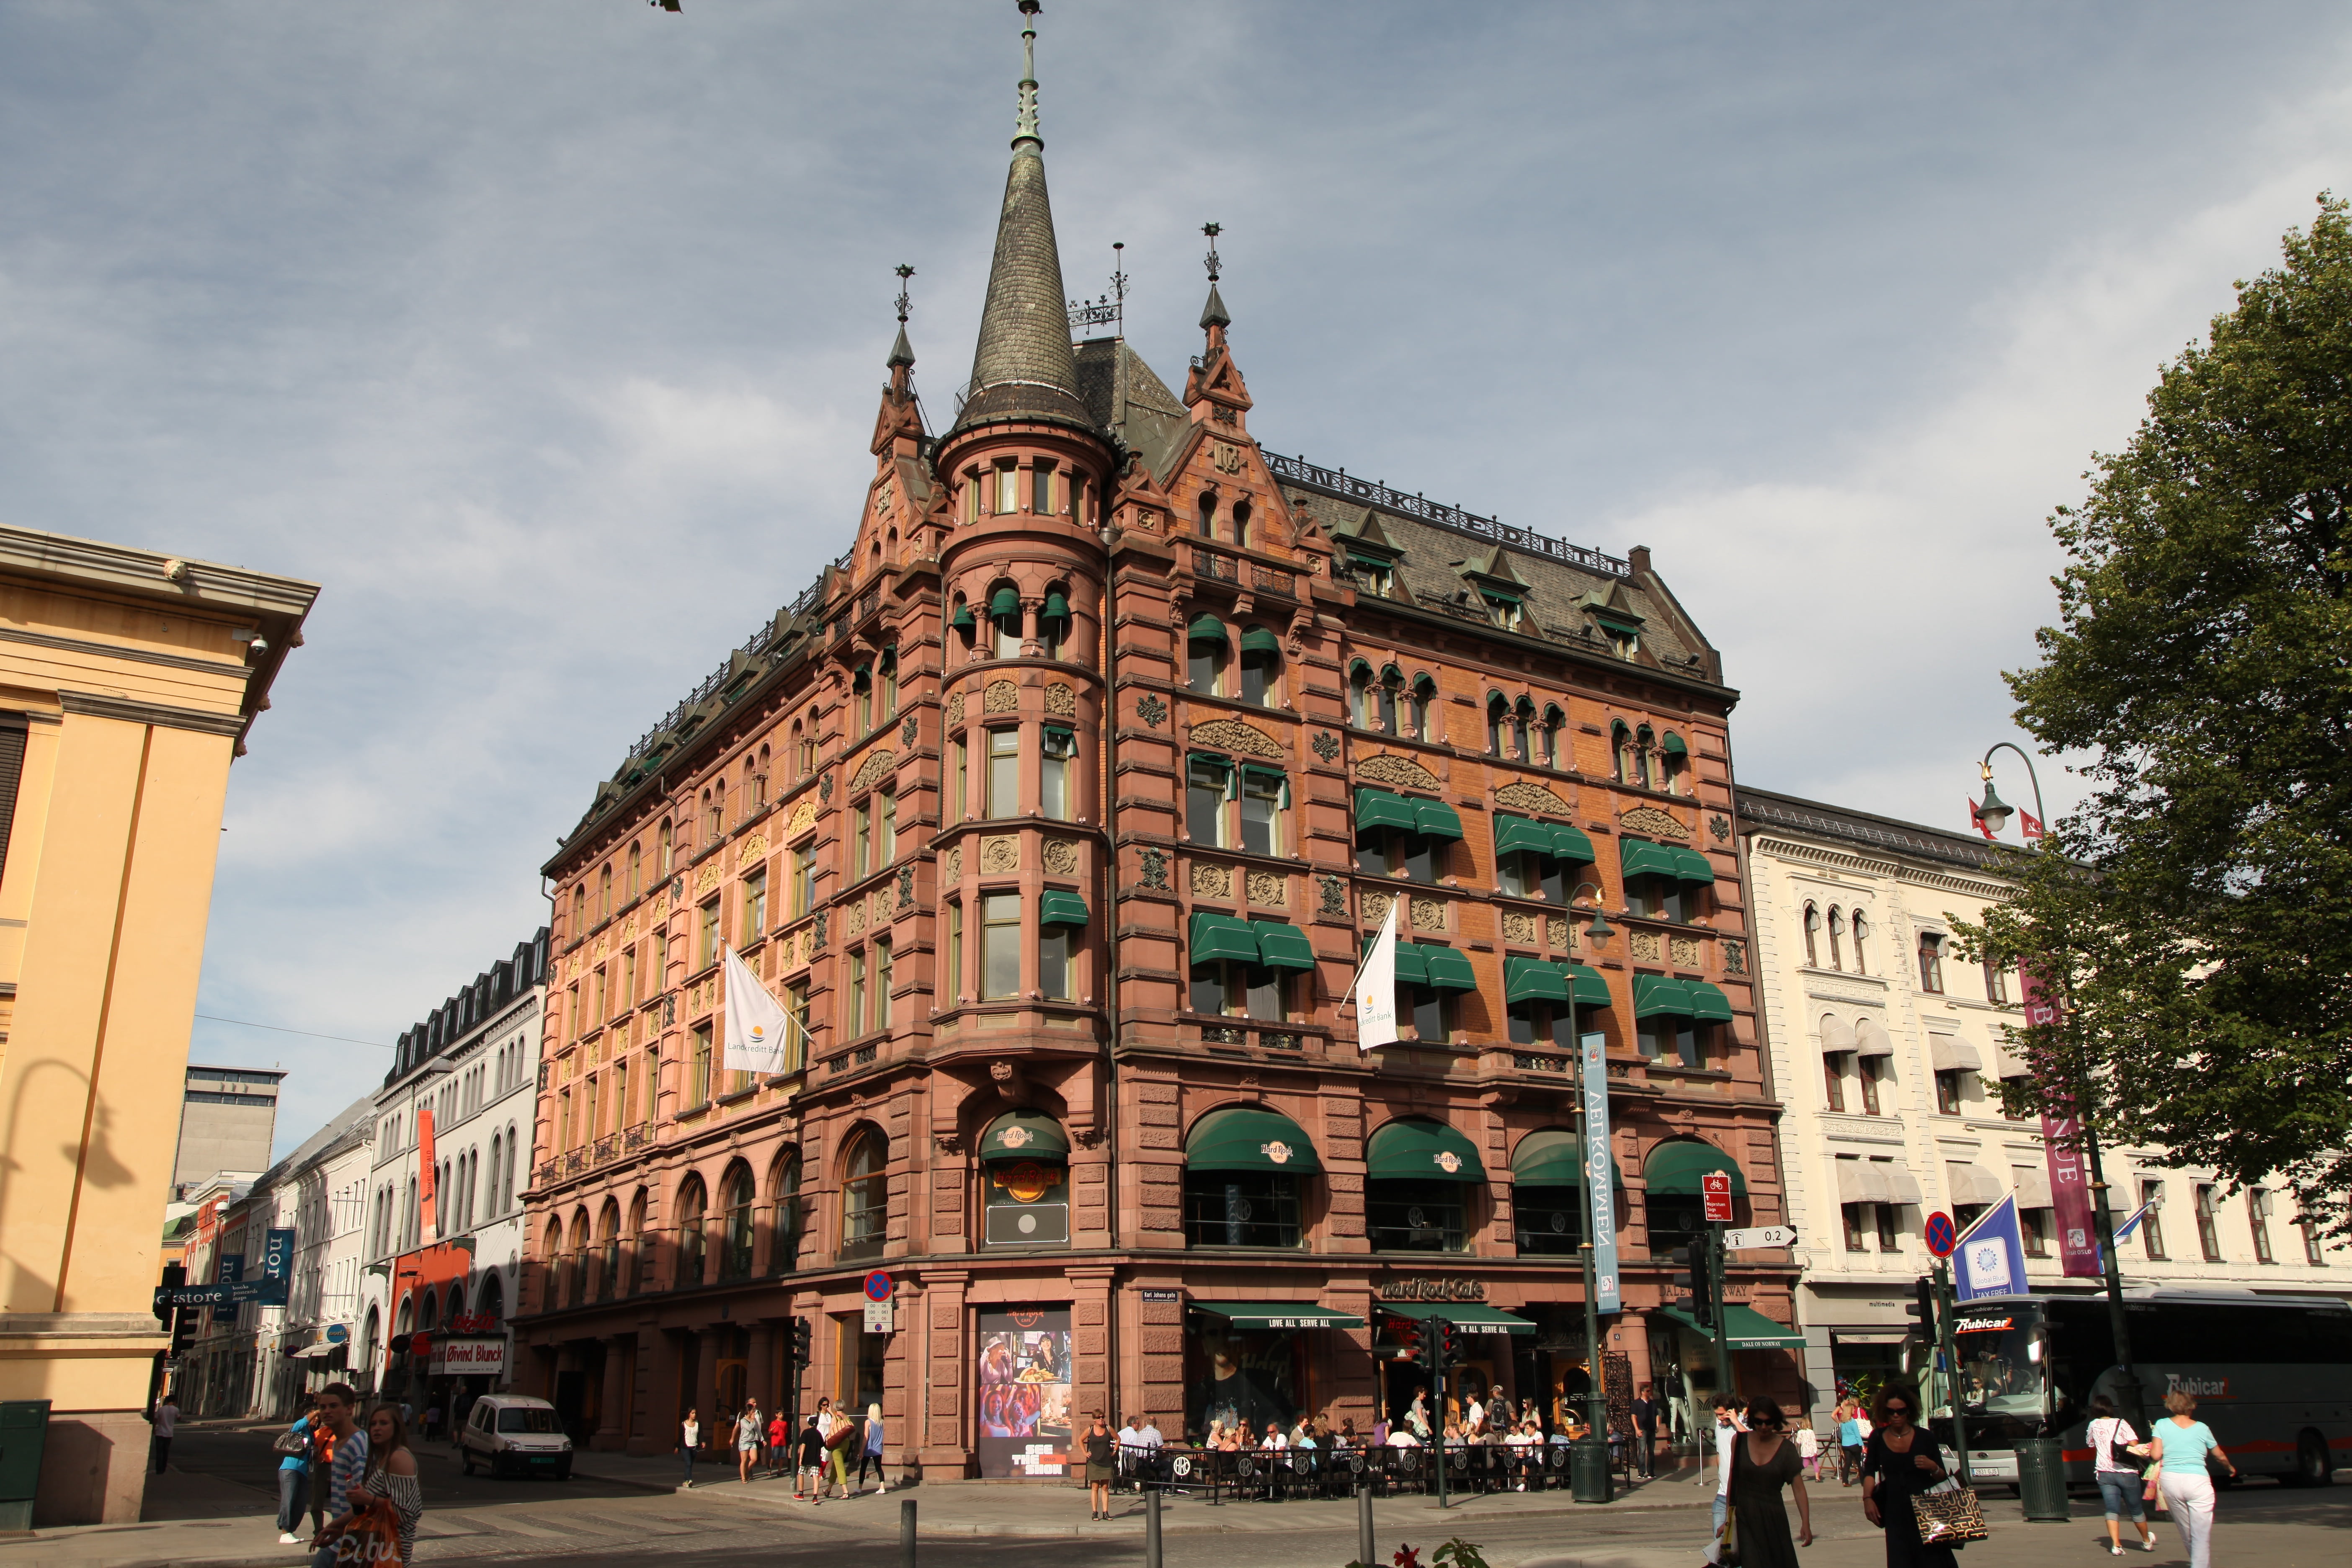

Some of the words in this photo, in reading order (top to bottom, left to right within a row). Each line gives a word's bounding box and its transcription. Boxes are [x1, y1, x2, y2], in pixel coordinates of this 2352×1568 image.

[1270, 456, 1626, 575] ANDKREDITT
[1377, 1011, 1392, 1021] Bank
[728, 1042, 767, 1053] Landkreditt
[769, 1046, 784, 1055] Bank
[997, 1131, 1014, 1142] Hard
[1014, 1130, 1033, 1142] Rock
[1261, 1144, 1277, 1154] Hard
[1278, 1145, 1293, 1157] Rock
[1434, 1154, 1448, 1163] Hard
[1449, 1155, 1462, 1166] Rock
[996, 1171, 1026, 1184] Hard
[1028, 1168, 1058, 1185] Rock
[1765, 1230, 1781, 1242] 0,2
[1975, 1276, 1992, 1285] Global
[1381, 1278, 1417, 1296] Hard
[1417, 1278, 1452, 1300] Rock
[1452, 1278, 1485, 1296] Cafe
[1659, 1286, 1685, 1297] DALE
[1006, 1308, 1026, 1316] Hard
[1027, 1307, 1044, 1318] Rock
[1953, 1318, 2009, 1333] Rubicar
[446, 1345, 472, 1362] Øivind
[476, 1344, 502, 1362] Blunck
[2164, 1374, 2225, 1398] Rubicar
[1025, 1444, 1053, 1455] SEE
[1012, 1455, 1039, 1465] THE
[1025, 1464, 1063, 1475] SHOW
